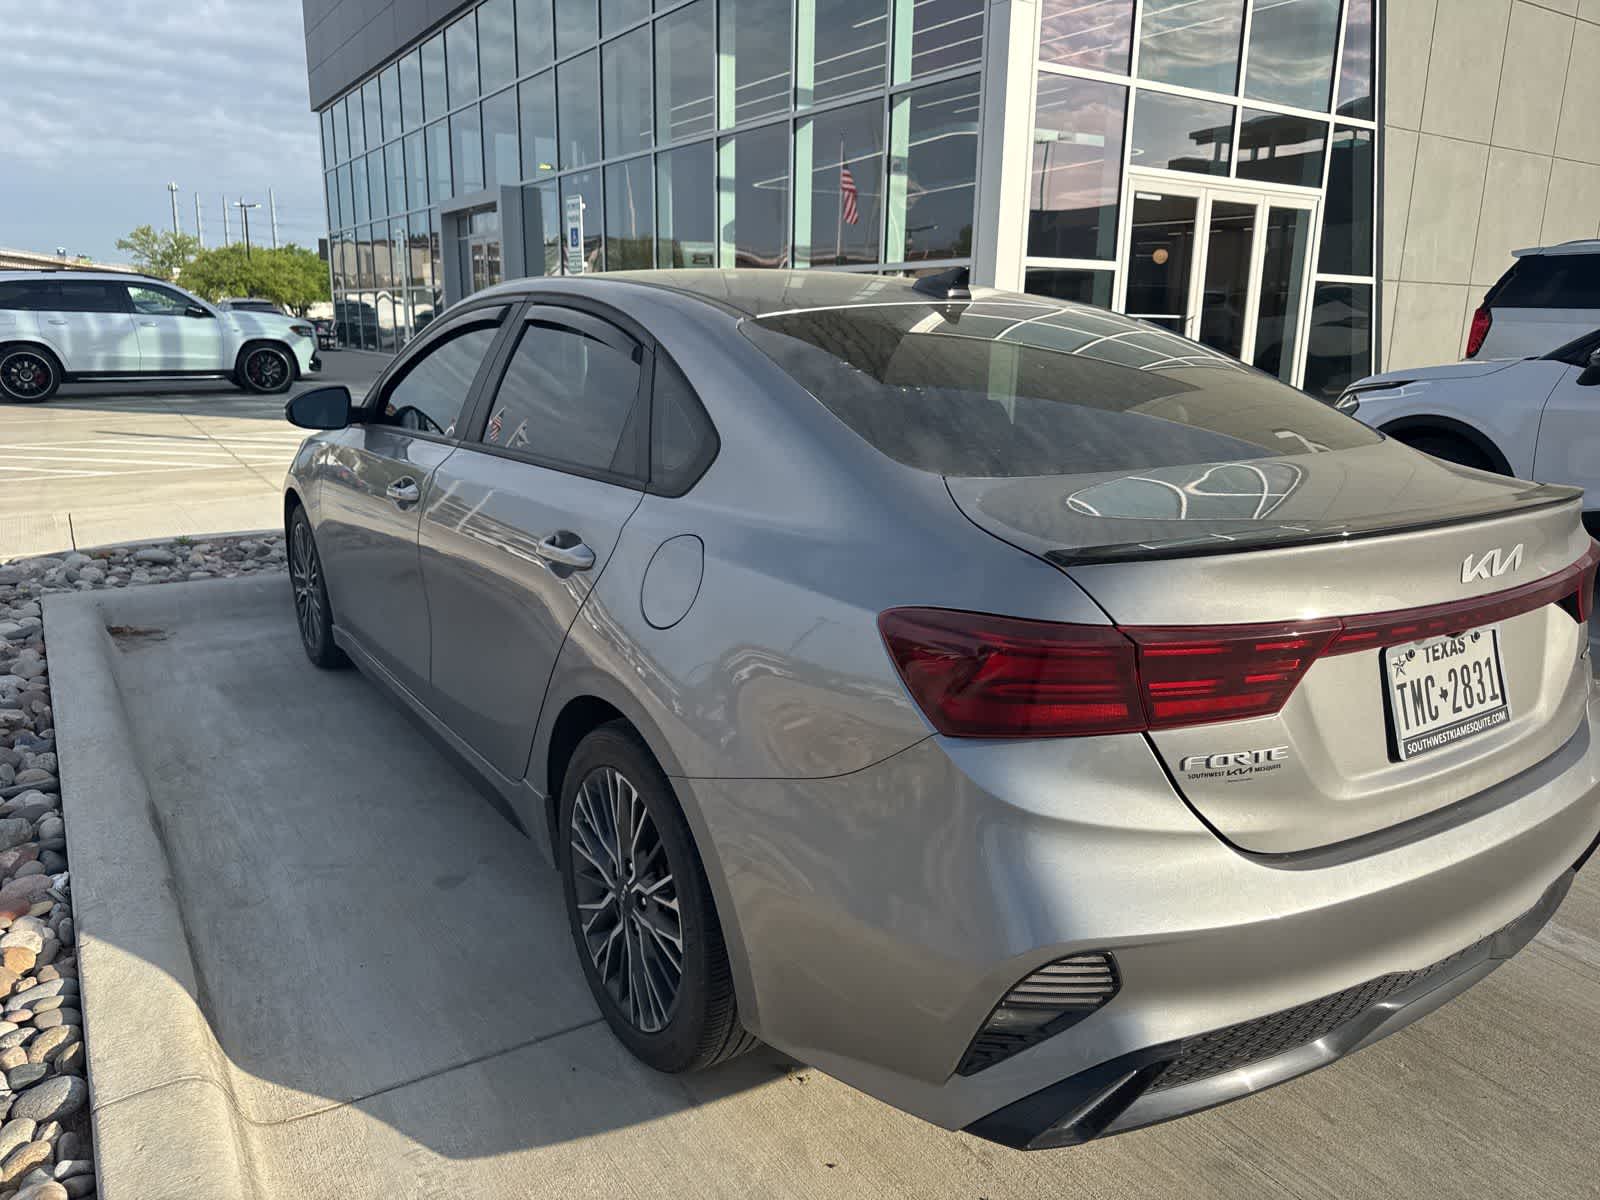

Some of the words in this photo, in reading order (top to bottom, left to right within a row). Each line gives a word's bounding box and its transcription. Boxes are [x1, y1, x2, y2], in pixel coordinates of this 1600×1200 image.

[1460, 543, 1524, 584] KIA
[1423, 637, 1466, 663] TEXAS
[1397, 675, 1439, 730] TMC
[1448, 656, 1500, 714] 2831
[1407, 711, 1507, 754] SOUTHWESTKIAMESQUITE.COM
[1179, 745, 1289, 771] FORTE
